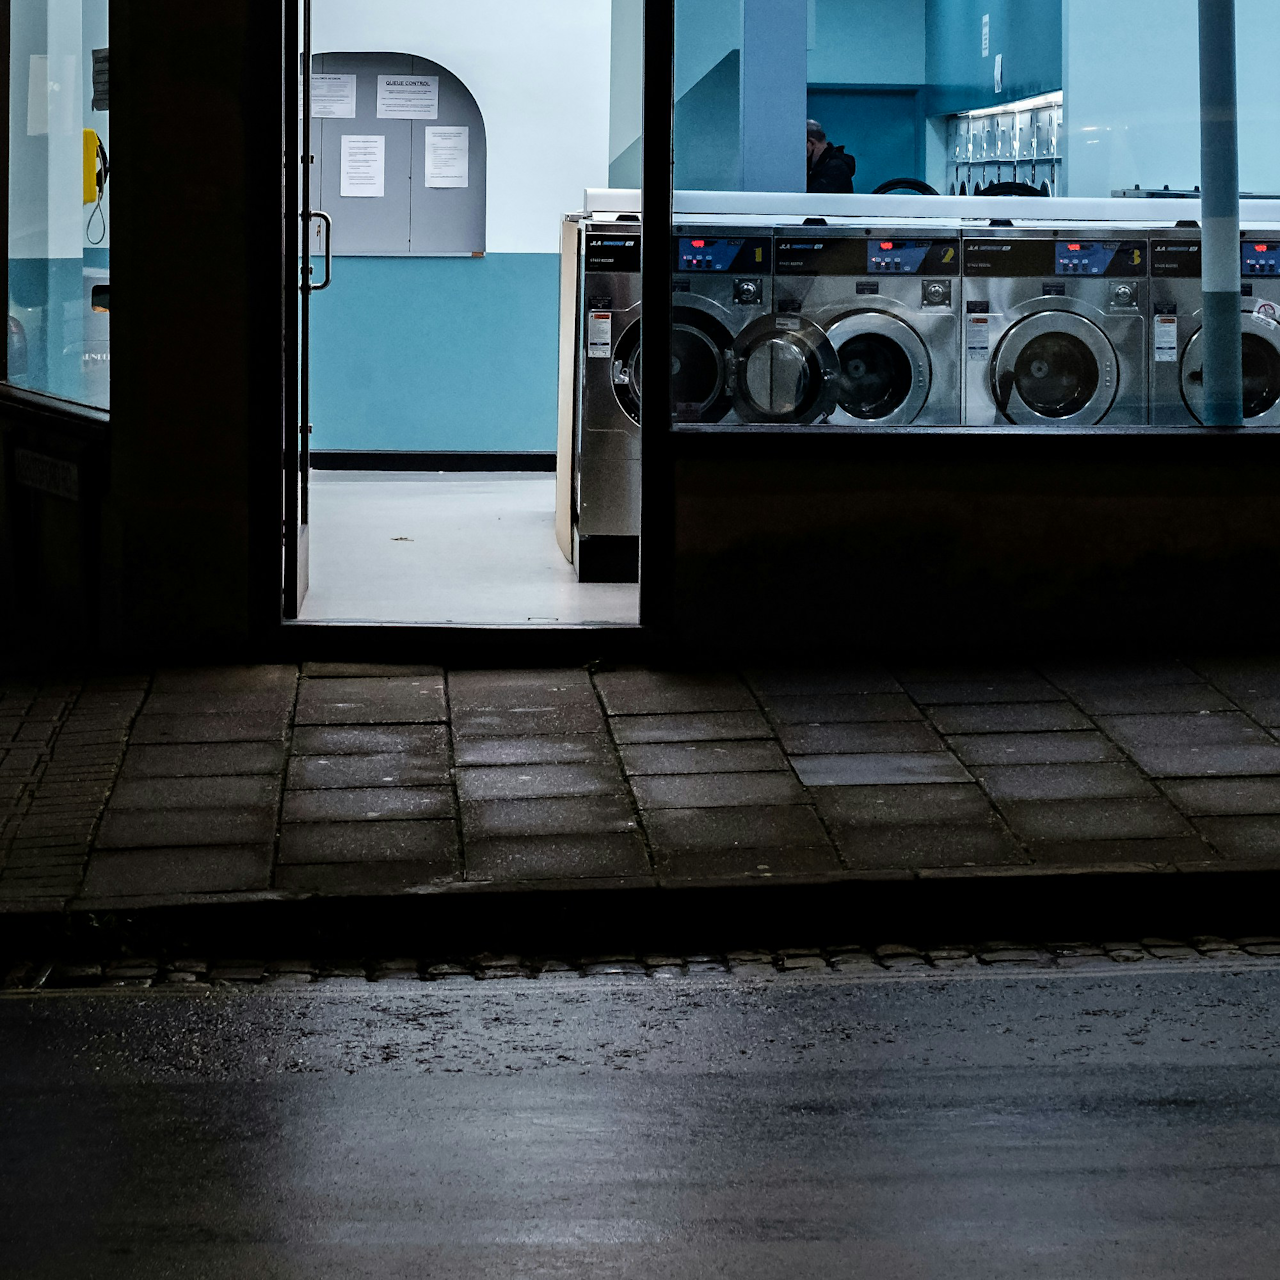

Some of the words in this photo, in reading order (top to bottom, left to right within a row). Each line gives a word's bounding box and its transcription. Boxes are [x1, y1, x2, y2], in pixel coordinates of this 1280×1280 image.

[753, 246, 763, 263] 1
[941, 246, 955, 264] 2
[1128, 248, 1142, 266] 3
